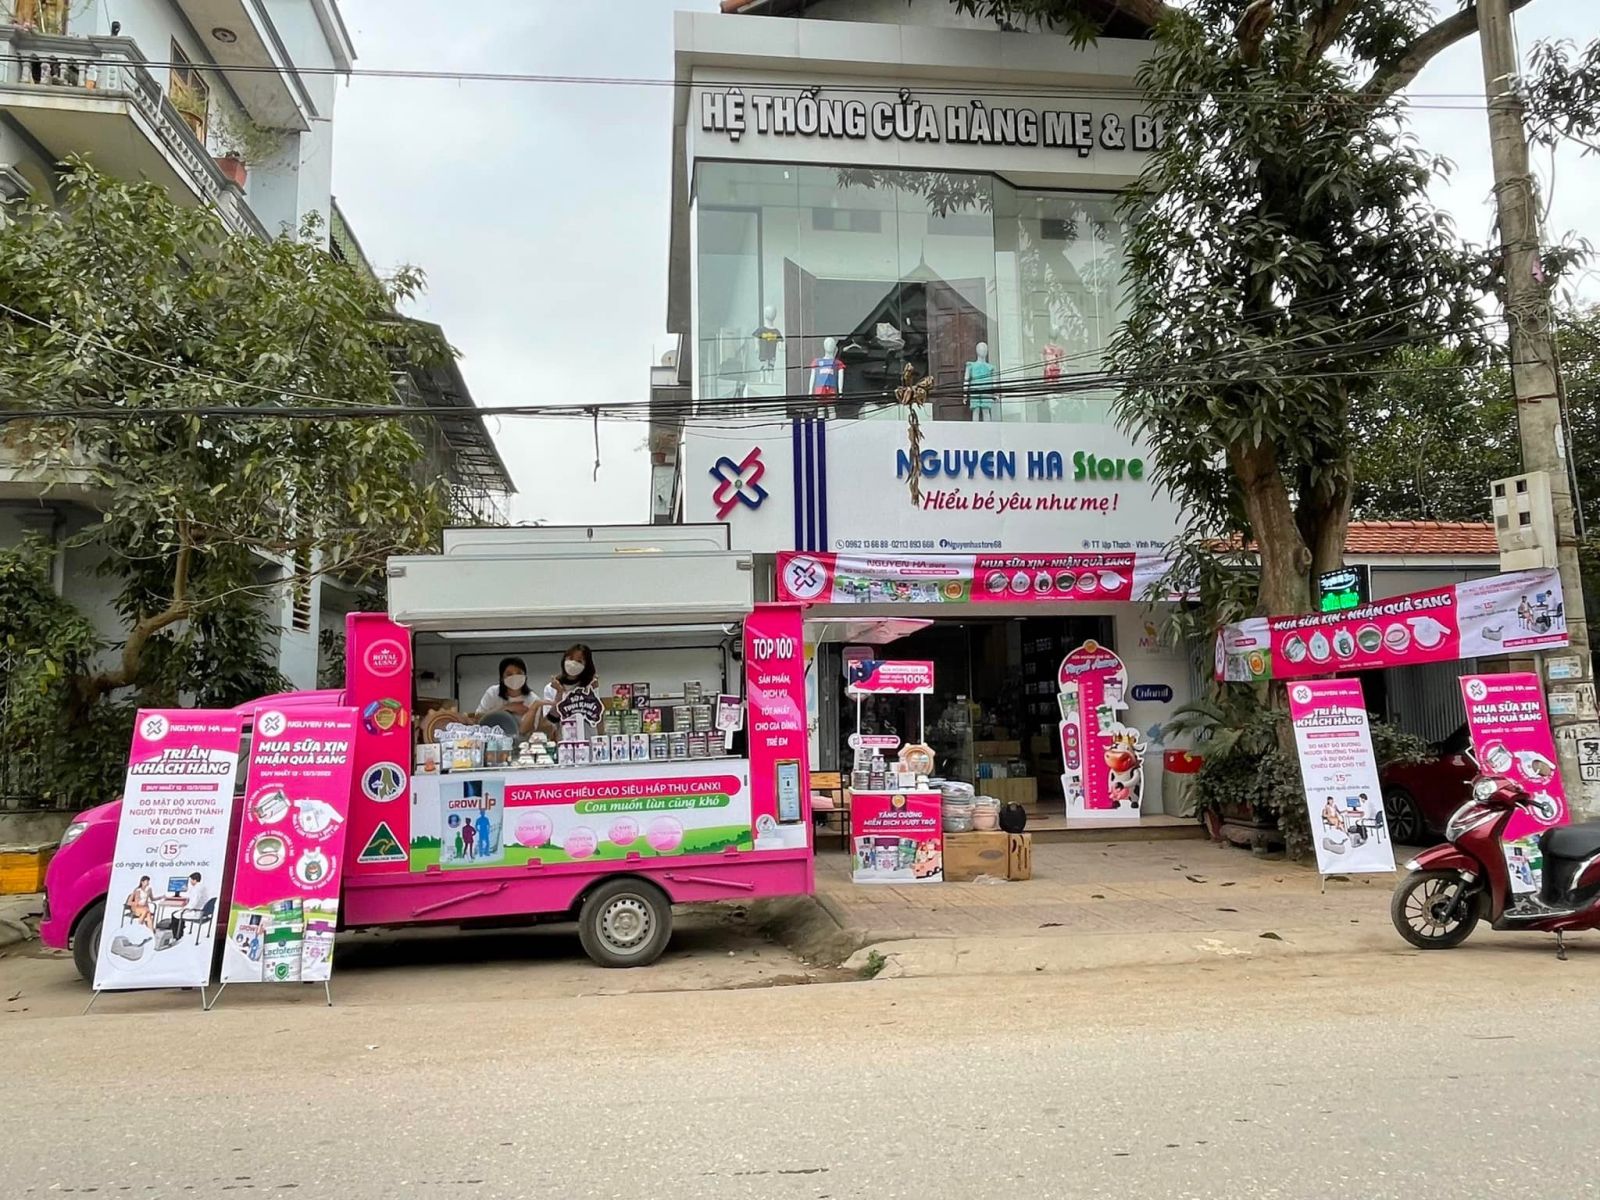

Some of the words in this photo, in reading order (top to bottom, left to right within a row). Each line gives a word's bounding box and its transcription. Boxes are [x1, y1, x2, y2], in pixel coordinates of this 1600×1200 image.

[702, 87, 746, 141] HỆ
[752, 86, 867, 140] THỐNG
[872, 88, 940, 143] CỬA
[946, 100, 1037, 146] HÀNG
[1043, 111, 1093, 157] MẸ
[1100, 113, 1125, 149] &
[1132, 115, 1164, 151] B
[896, 448, 1017, 481] NGUYEN
[1027, 451, 1063, 481] HA
[1073, 450, 1143, 480] Store
[924, 488, 968, 511] Hiểu
[972, 490, 995, 510] bé
[997, 493, 1032, 515] yêu
[1036, 493, 1078, 510] như
[1081, 499, 1109, 515] mẹ
[981, 559, 1004, 569] MUA
[1005, 557, 1027, 569] SỮA
[1028, 559, 1045, 571] XỊN
[1051, 556, 1080, 570] NHẬN
[1081, 556, 1103, 568] QUÀ
[1104, 557, 1131, 567] SANG
[1273, 620, 1298, 632] MUA
[1299, 615, 1319, 628] SỮA
[1348, 604, 1383, 621] NHẬN
[1384, 597, 1414, 616] QUÀ
[1415, 594, 1452, 610] SANG
[753, 638, 774, 660] TOP
[776, 638, 793, 660] 100
[373, 653, 397, 661] ROYAL
[903, 674, 930, 684] 100%
[1313, 708, 1330, 717] TRI
[1331, 704, 1347, 717] ÂN
[1472, 703, 1497, 714] MUA
[1498, 700, 1519, 713] SỮA
[1520, 701, 1540, 713] XỊN
[1296, 715, 1332, 728] KHÁCH
[1333, 714, 1364, 726] HÀNG
[1473, 714, 1499, 726] NHẬN
[1500, 712, 1519, 724] QUÀ
[1520, 711, 1543, 722] SANG
[755, 722, 768, 731] CHO
[770, 722, 780, 730] GIA
[258, 741, 291, 753] MUA
[293, 738, 320, 752] SỮA
[322, 741, 349, 757] XỊN
[780, 737, 788, 745] EM
[162, 748, 186, 761] TRI
[188, 744, 211, 761] ÂN
[254, 752, 289, 767] NHẬN
[290, 752, 315, 765] QUÀ
[316, 754, 347, 765] SANG
[132, 759, 186, 775] KHÁCH
[187, 760, 231, 775] HÀNG
[511, 788, 533, 802] SỮA
[534, 787, 561, 801] TĂNG
[598, 786, 619, 797] CAO
[621, 784, 645, 796] SIÊU
[647, 780, 668, 794] HẤP
[669, 783, 689, 796] THỤ
[690, 782, 720, 793] CANXI
[585, 801, 606, 811] Con
[610, 797, 642, 811] muốn
[646, 798, 666, 809] lùn
[668, 797, 695, 810] cũng
[699, 795, 719, 806] khó
[161, 827, 178, 835] CAO
[180, 827, 198, 835] CHO
[163, 844, 178, 855] 15
